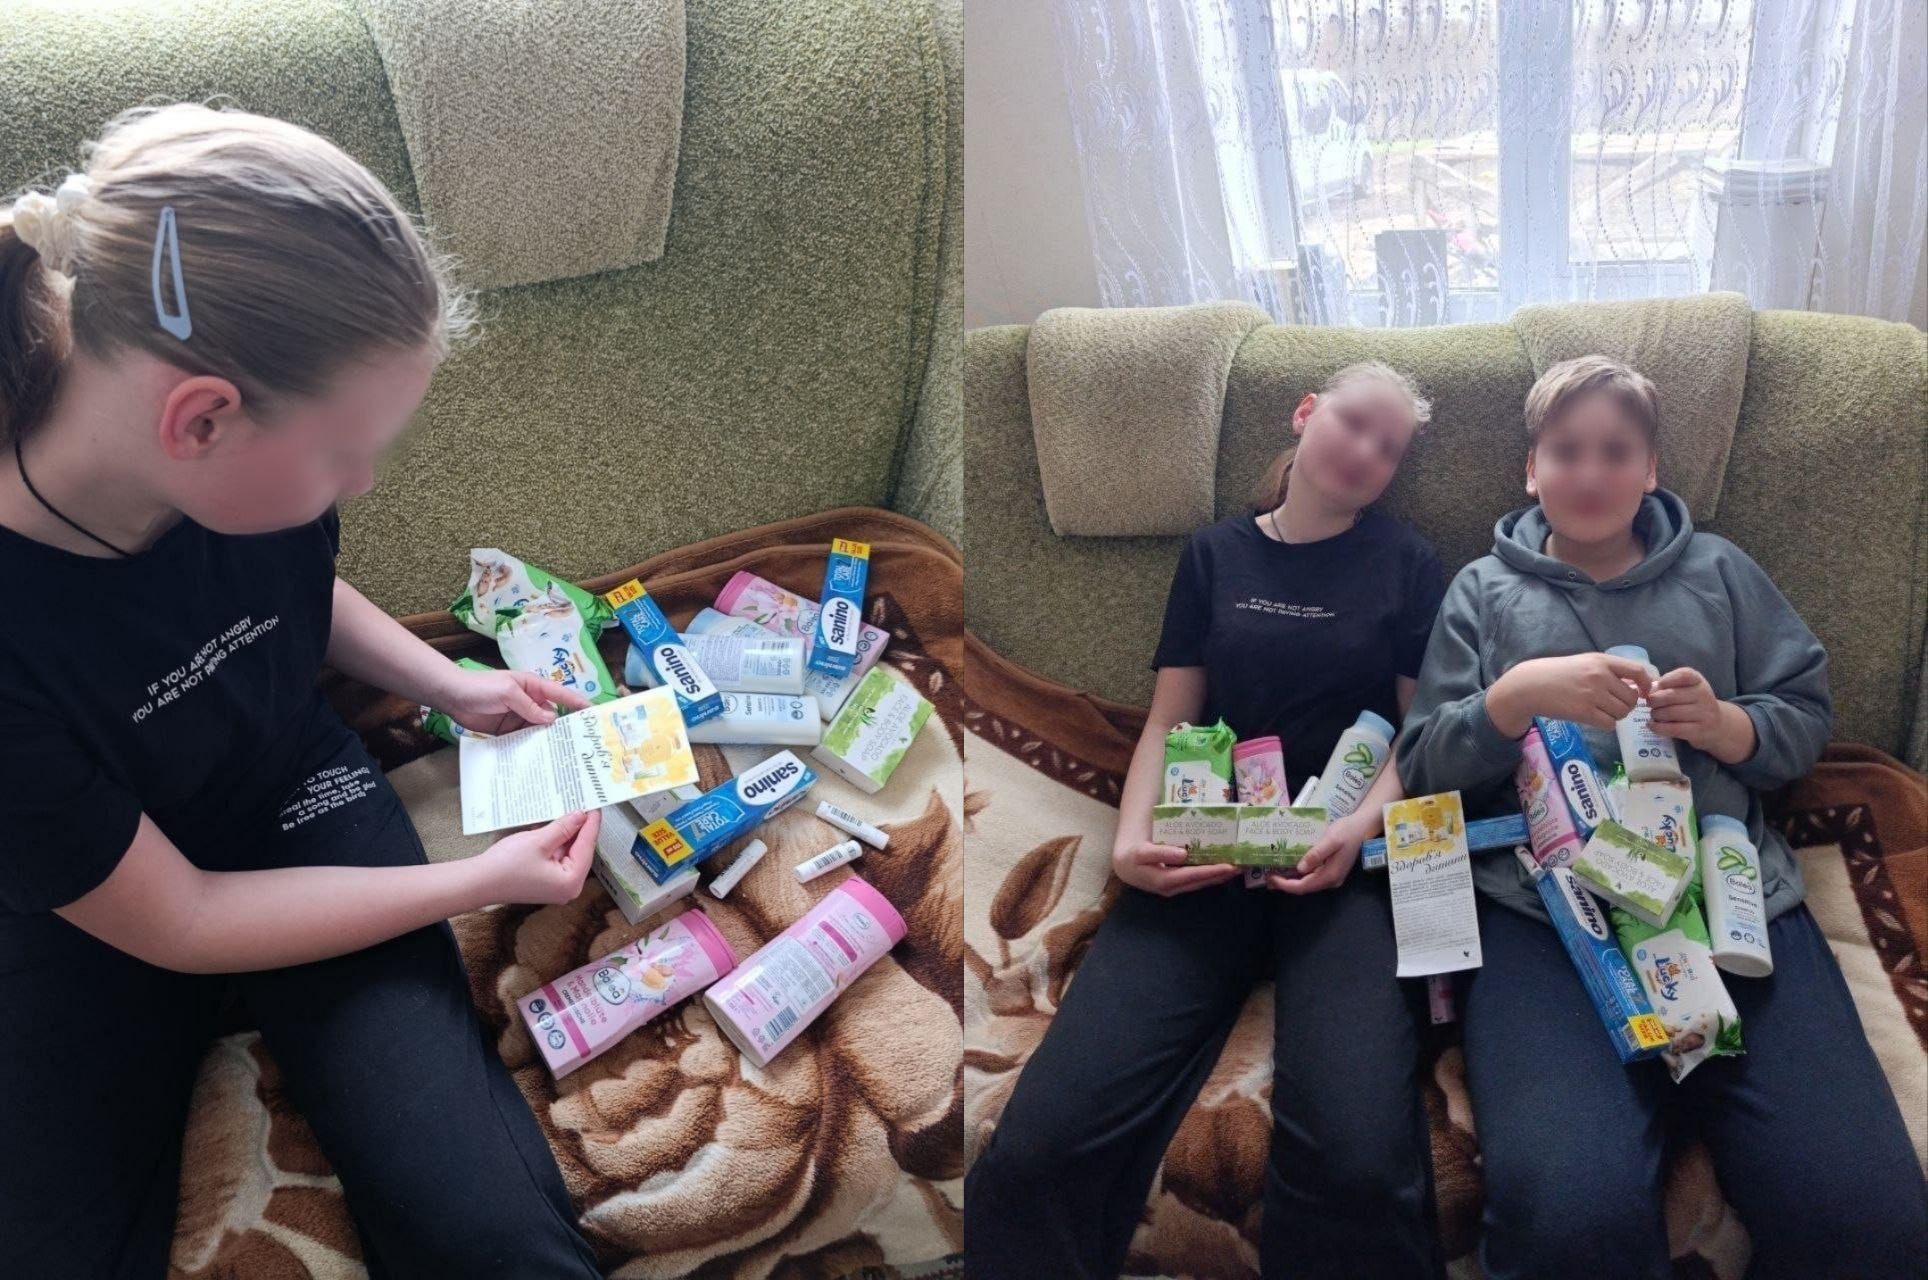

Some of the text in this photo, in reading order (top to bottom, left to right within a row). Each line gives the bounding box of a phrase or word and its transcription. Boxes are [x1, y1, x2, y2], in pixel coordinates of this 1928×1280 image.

[828, 600, 848, 644] sanino
[132, 702, 153, 723] YOU
[157, 687, 180, 708] ARE
[181, 671, 203, 692] NOT
[228, 615, 279, 653] ATTENTION
[147, 682, 159, 696] IF
[162, 666, 186, 687] YOU
[200, 638, 218, 657] NOT
[220, 616, 253, 643] ANGRY
[552, 647, 577, 688] Lucky
[660, 647, 701, 695] sanino
[307, 780, 332, 794] YOUR
[317, 766, 348, 780] TOUCH
[744, 762, 799, 799] sanino
[1568, 763, 1598, 820] sanino
[282, 822, 295, 831] Be
[297, 812, 316, 825] free
[330, 800, 345, 809] the
[302, 797, 317, 807] the
[307, 799, 330, 812] song
[331, 791, 348, 802] and
[349, 786, 361, 795] be
[1565, 874, 1603, 935] sanino
[1654, 956, 1678, 1002] Lucky
